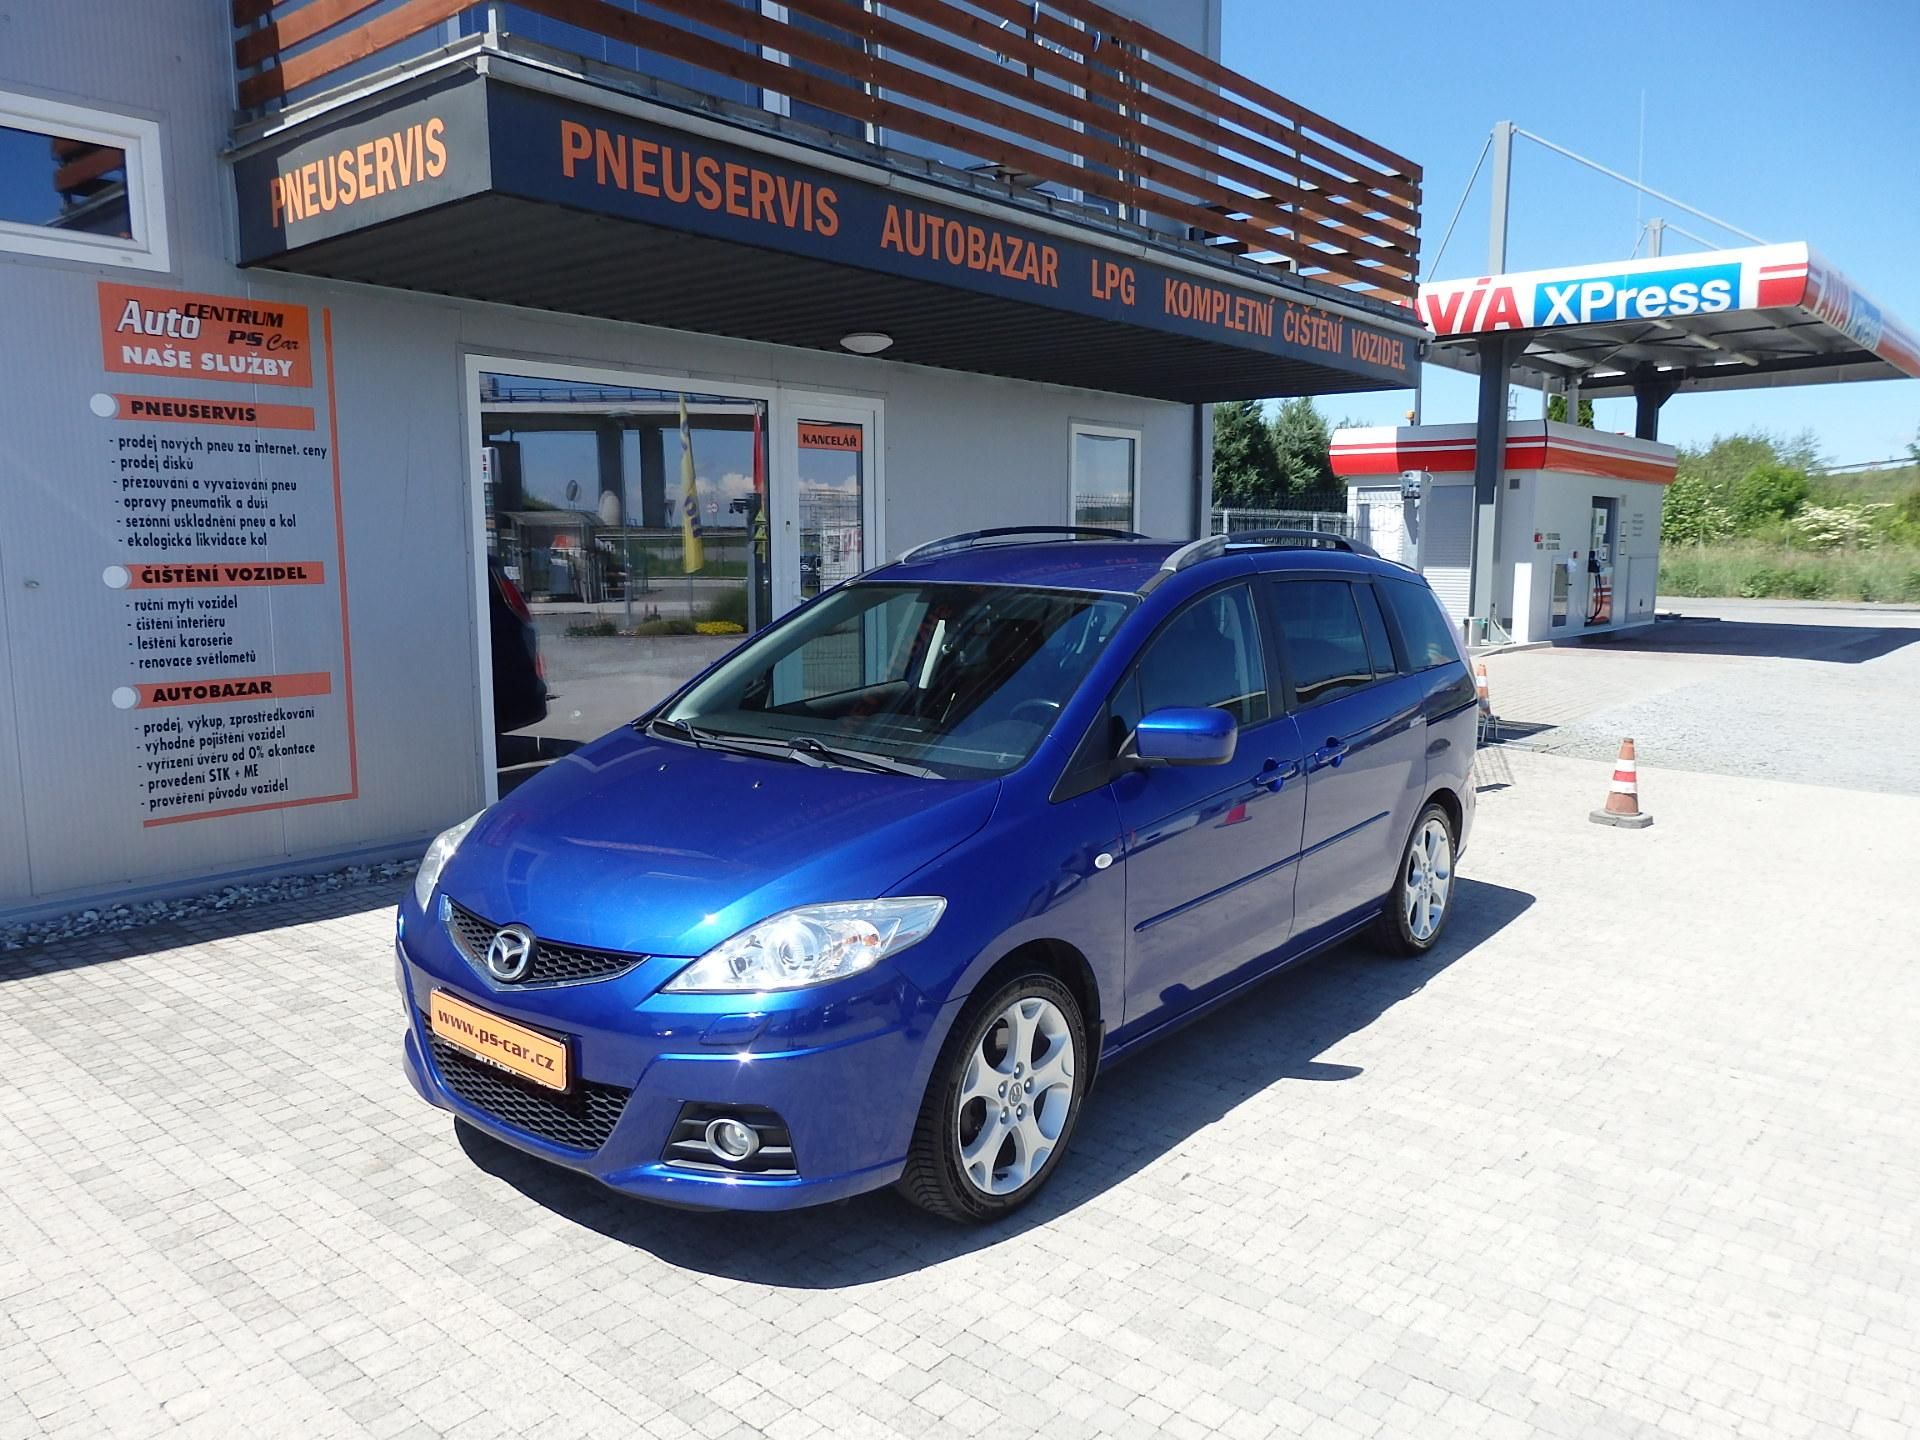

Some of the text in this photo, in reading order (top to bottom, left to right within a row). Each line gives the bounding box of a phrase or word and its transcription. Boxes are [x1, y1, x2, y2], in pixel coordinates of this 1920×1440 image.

[270, 117, 448, 229] PNEUSERVIS
[560, 119, 1406, 370] PNEUSERVIS AUTOBAZAR LPG KOMPLETNÍ ČIŠTĚNÍ VOZIDEL
[1544, 277, 1732, 324] XPress
[115, 299, 284, 340] Auto CENTRUM
[228, 330, 300, 351] PS Car
[122, 344, 294, 377] NAŠE SLUŽBY
[131, 400, 257, 422] PNEUSERVIS
[118, 434, 328, 460] prodej nových pneu za internet. ceny
[802, 433, 857, 447] KANCELÁŘ
[120, 454, 194, 473] prodej disků
[122, 476, 297, 494] přezouvání a vyvažování pneu
[124, 498, 166, 512] opravy
[171, 495, 232, 512] pneumatik
[236, 500, 243, 509] a
[126, 513, 296, 530] sezónní uskladnění pneu a kol
[127, 532, 267, 550] ekologická likvidace kol
[141, 565, 307, 584] ČIŠTĚNÍ VOZIDEL
[135, 598, 163, 611] ruční
[198, 594, 238, 610] vozidel
[136, 615, 225, 631] čištění interiéru
[137, 632, 233, 650] leštění karoserie
[139, 650, 256, 669] renovace světlometů
[152, 681, 273, 703] AUTOBAZAR
[143, 717, 184, 737] prodej,
[229, 706, 315, 728] zprostředkování
[145, 725, 286, 755] výhodné pojištění vozidel
[147, 743, 315, 774] vyřízení úvěru od 0% akontace
[148, 771, 206, 794] provedení
[209, 767, 231, 783] STK
[244, 763, 259, 779] ME
[149, 777, 288, 812] prověření původu vozidel
[438, 1009, 555, 1072] www.ps-car.cz
